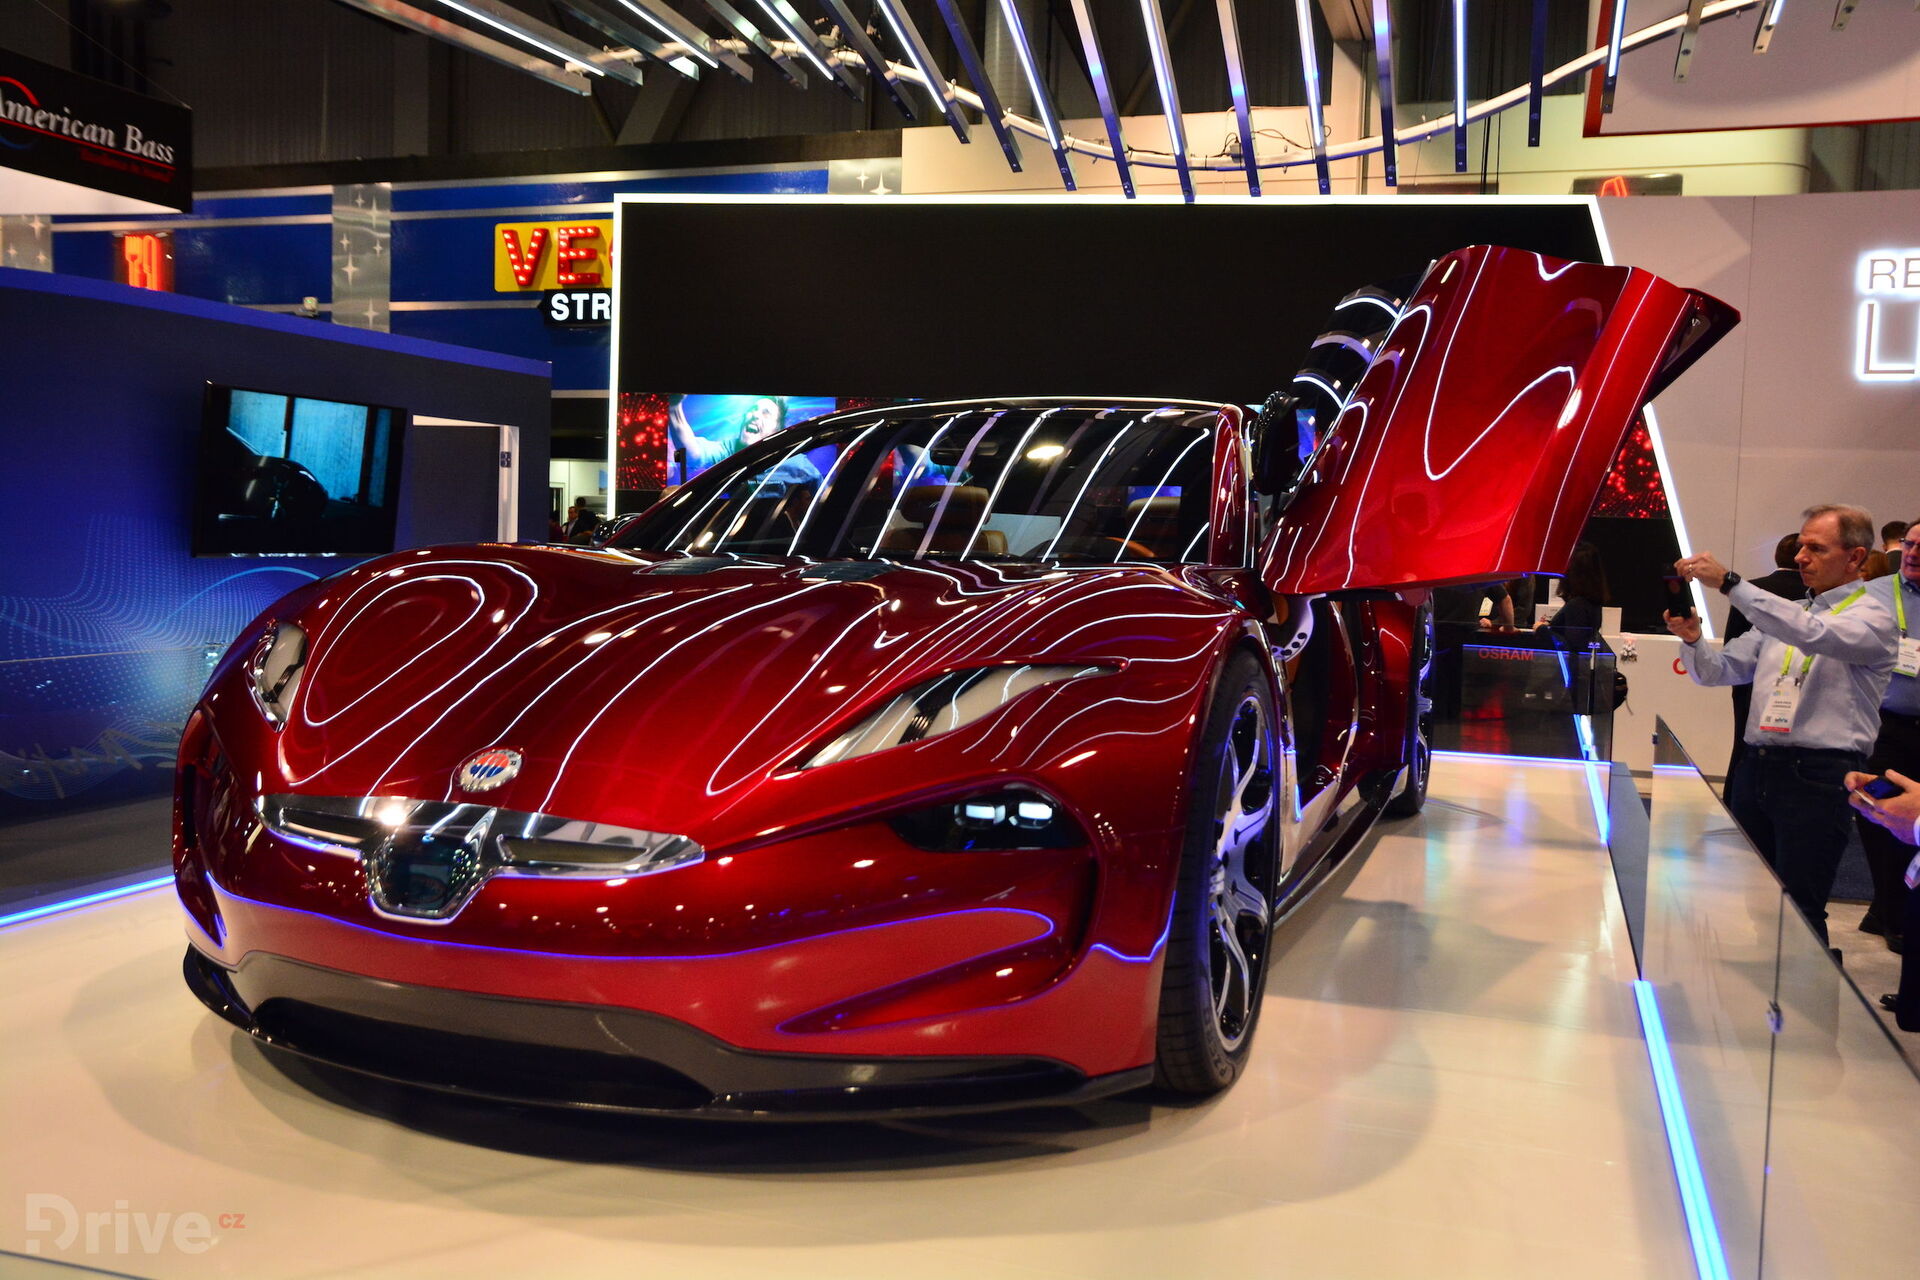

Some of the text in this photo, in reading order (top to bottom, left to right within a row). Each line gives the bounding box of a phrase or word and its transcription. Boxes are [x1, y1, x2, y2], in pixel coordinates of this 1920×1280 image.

[123, 123, 175, 164] Bass
[502, 226, 613, 287] VE
[1478, 648, 1534, 661] OSRAM
